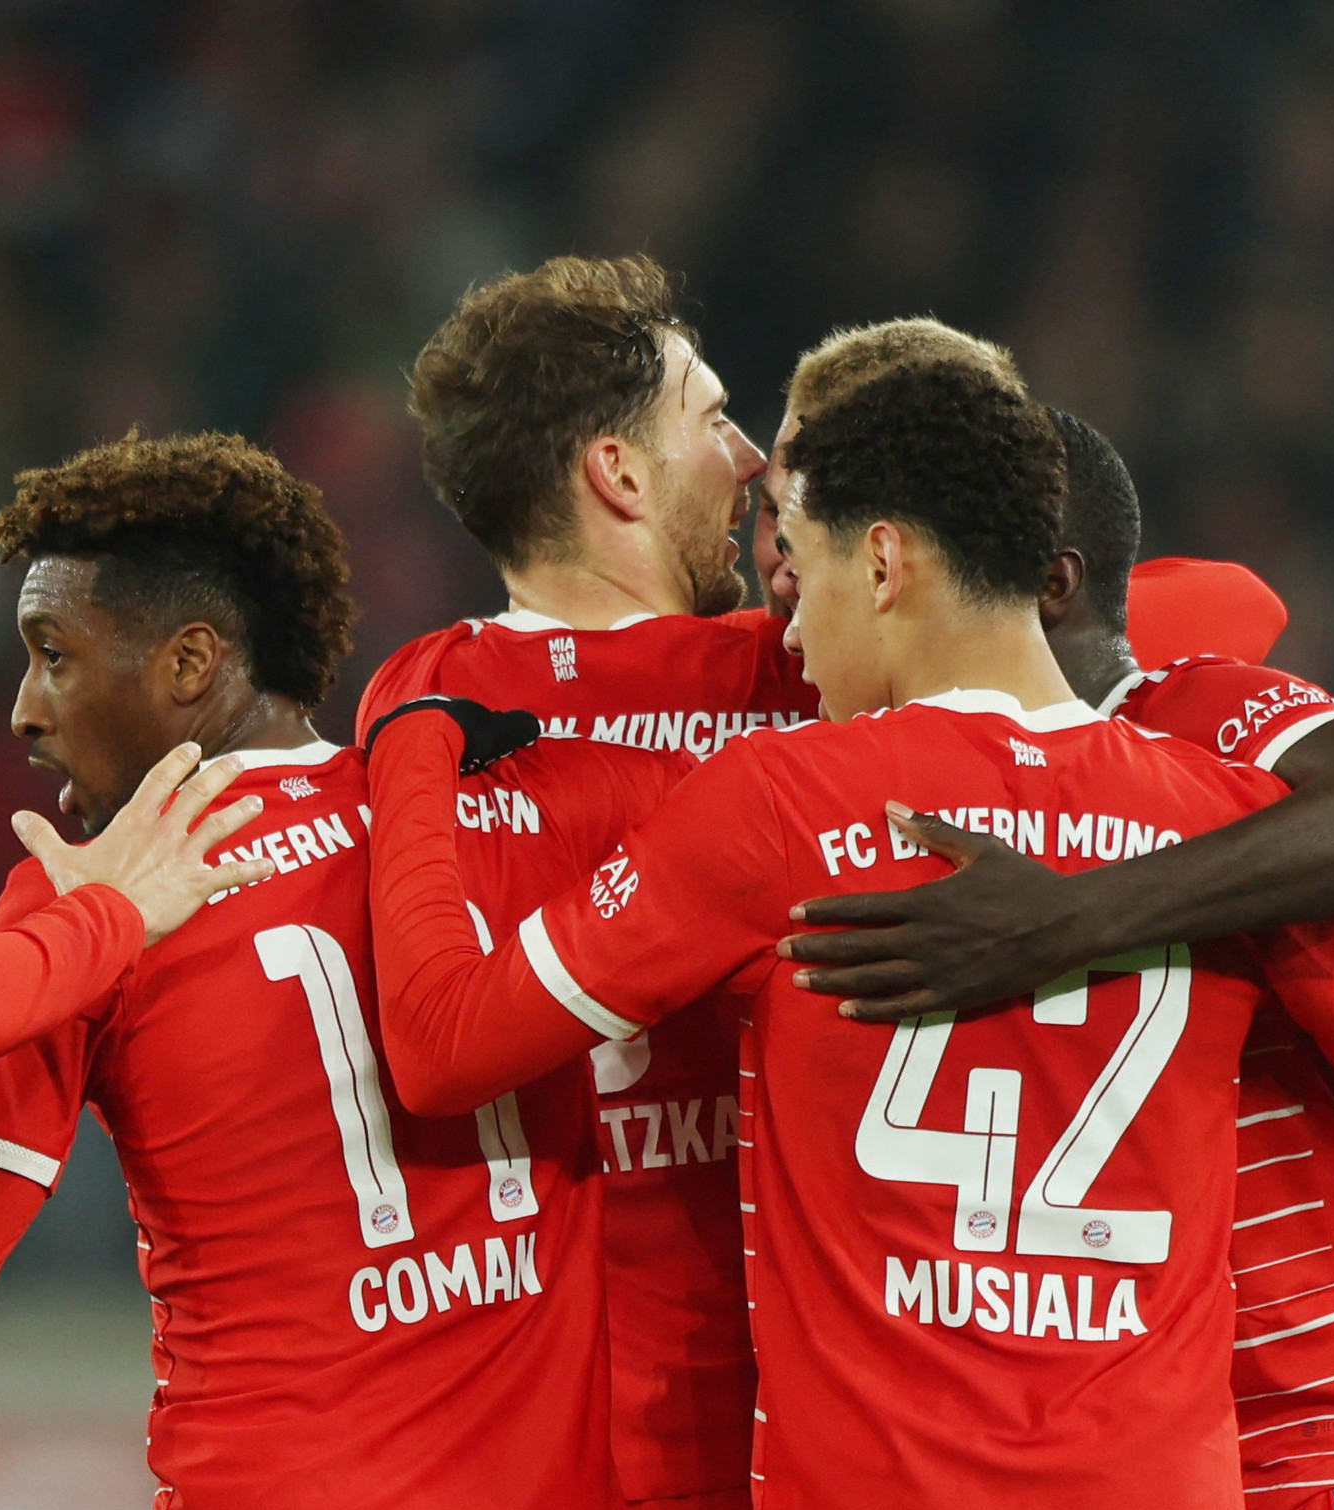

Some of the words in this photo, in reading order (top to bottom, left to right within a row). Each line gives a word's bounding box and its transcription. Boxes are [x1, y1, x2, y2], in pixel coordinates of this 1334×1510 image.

[548, 636, 576, 654] MIA
[551, 650, 576, 668] SAN
[554, 665, 579, 683] MIA
[818, 822, 877, 876] FC
[600, 1095, 740, 1173] TZKA
[854, 942, 1192, 1263] 42
[348, 1231, 543, 1332] COMAN
[884, 1255, 1149, 1342] MUSIALA
